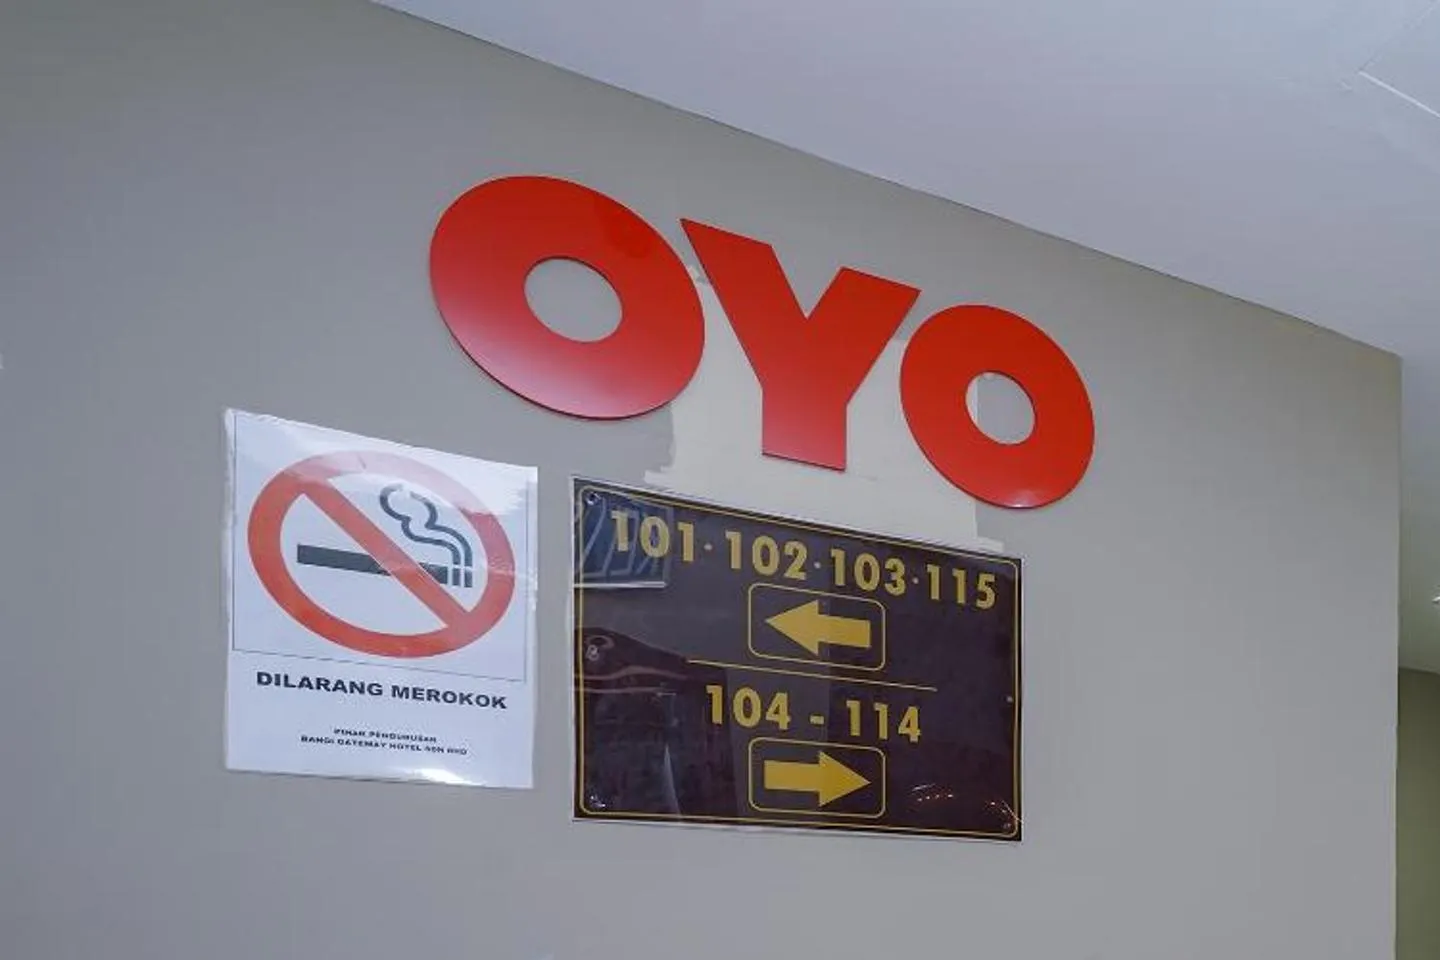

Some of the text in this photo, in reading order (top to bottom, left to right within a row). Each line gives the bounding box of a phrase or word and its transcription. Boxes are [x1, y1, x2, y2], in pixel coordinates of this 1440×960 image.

[429, 176, 1095, 509] OYO
[256, 671, 508, 710] DILARANG MEROKOK
[706, 685, 790, 731] 104
[846, 700, 921, 744] 114
